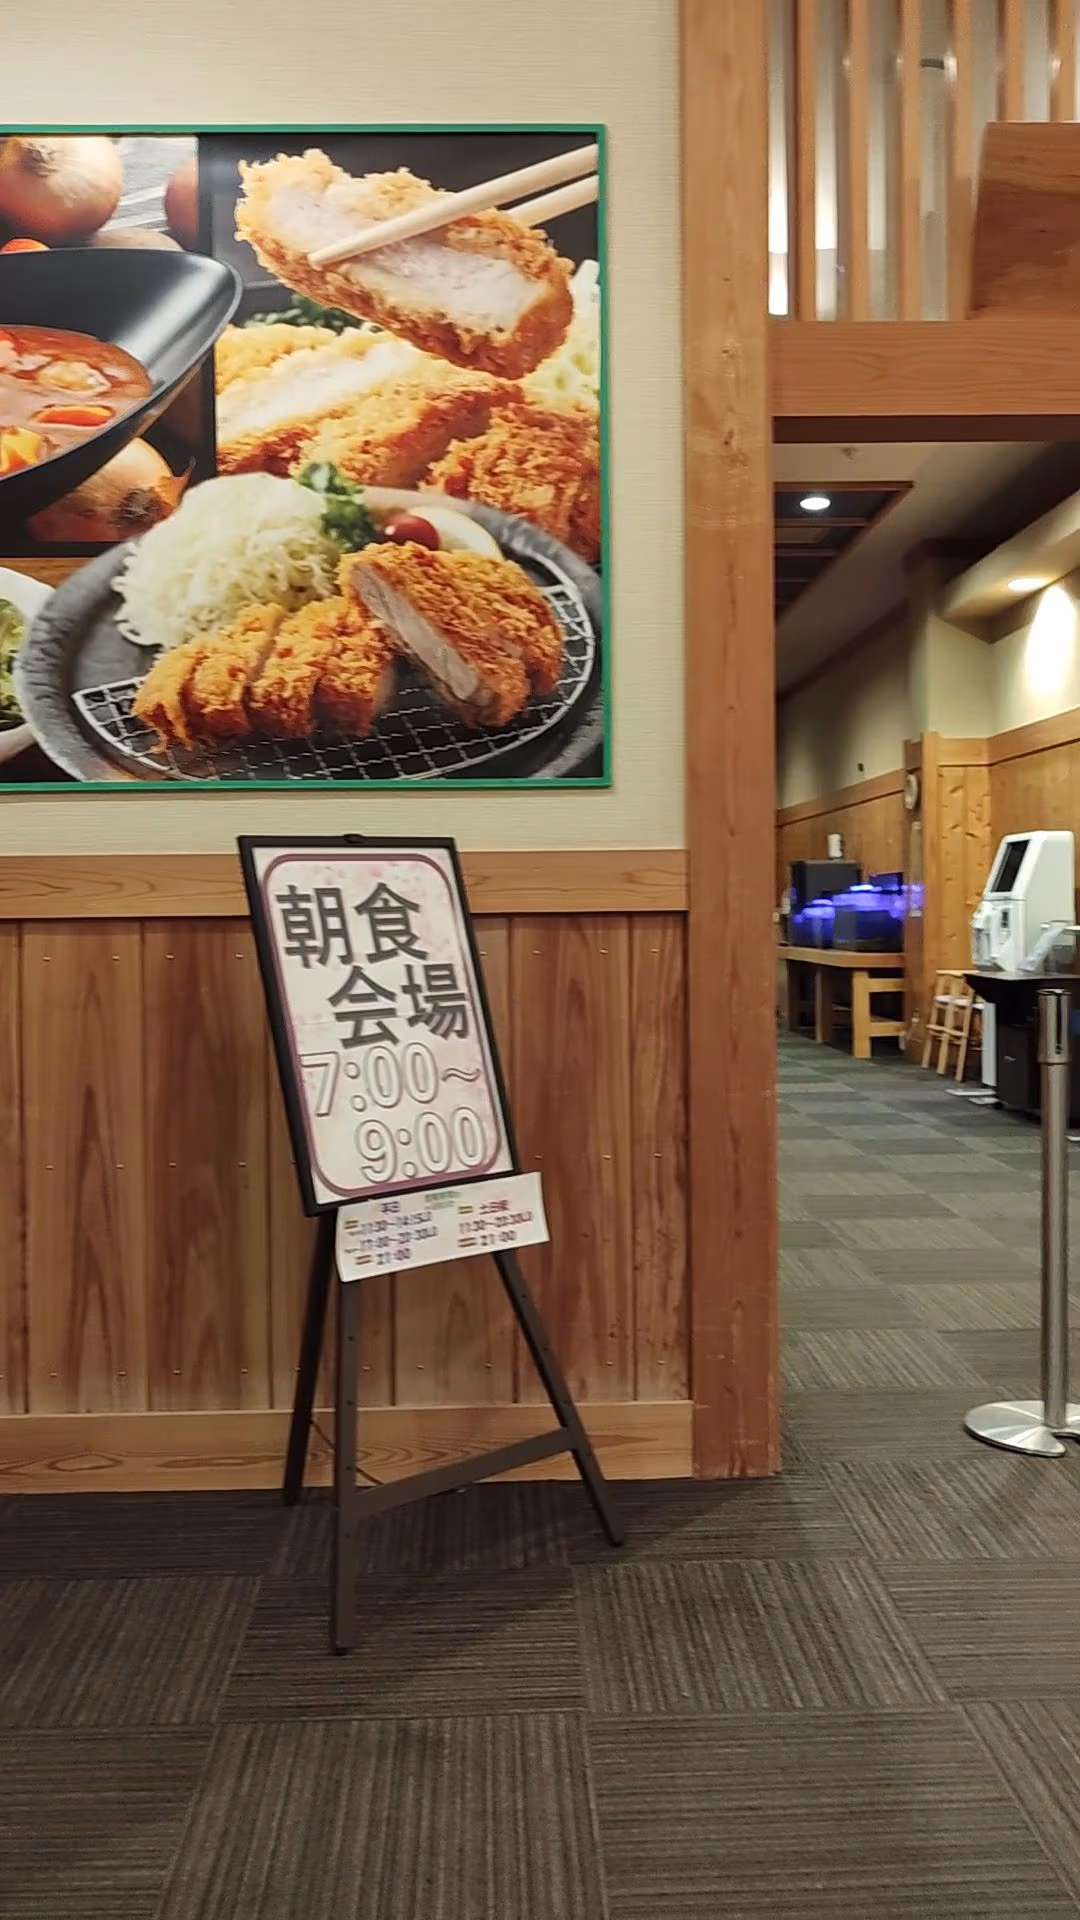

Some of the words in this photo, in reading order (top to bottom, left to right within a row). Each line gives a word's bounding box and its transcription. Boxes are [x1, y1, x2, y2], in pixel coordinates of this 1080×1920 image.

[275, 882, 428, 969] 朝食
[327, 962, 469, 1049] 会場
[354, 1107, 486, 1184] 9:00
